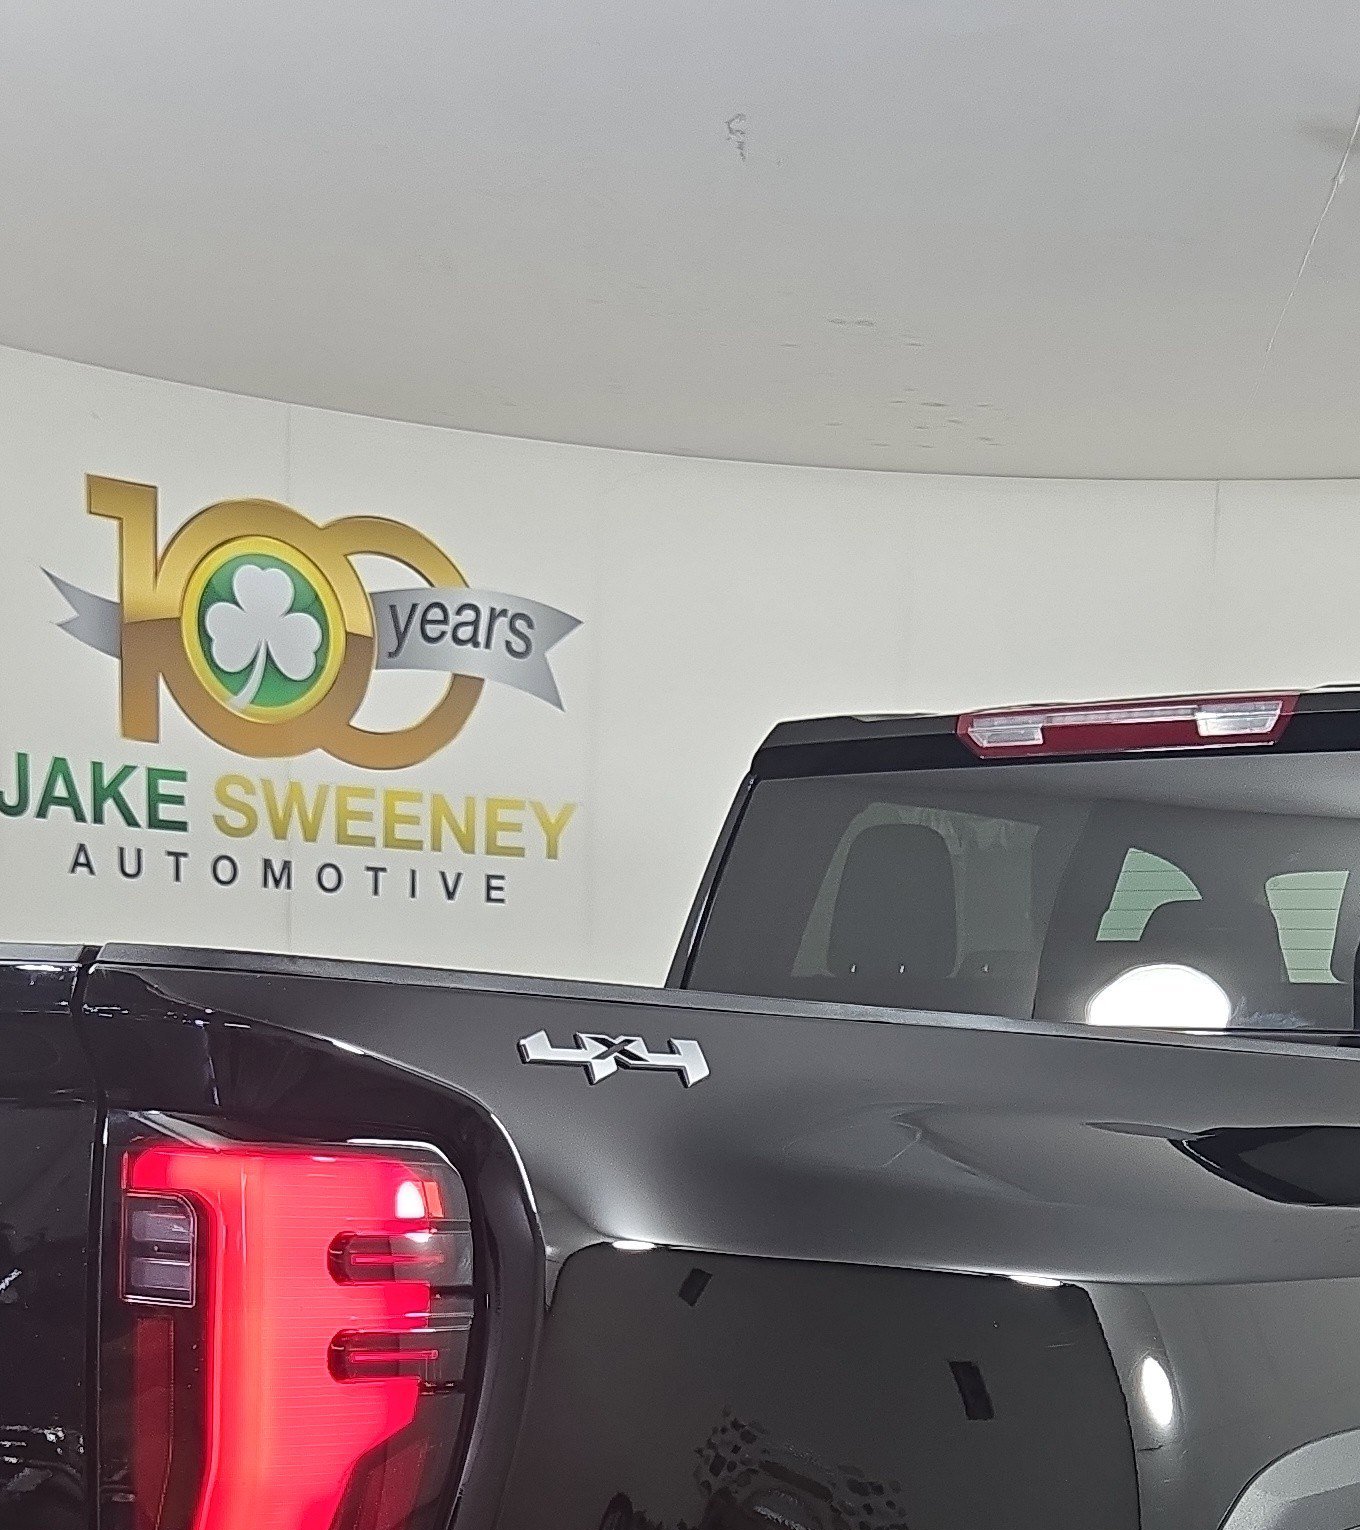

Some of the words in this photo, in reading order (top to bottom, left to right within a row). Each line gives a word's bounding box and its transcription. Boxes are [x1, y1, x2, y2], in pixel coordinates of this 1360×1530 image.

[386, 600, 536, 660] years
[212, 774, 577, 860] SWEENEY
[69, 842, 507, 904] AUTOMOTIVE
